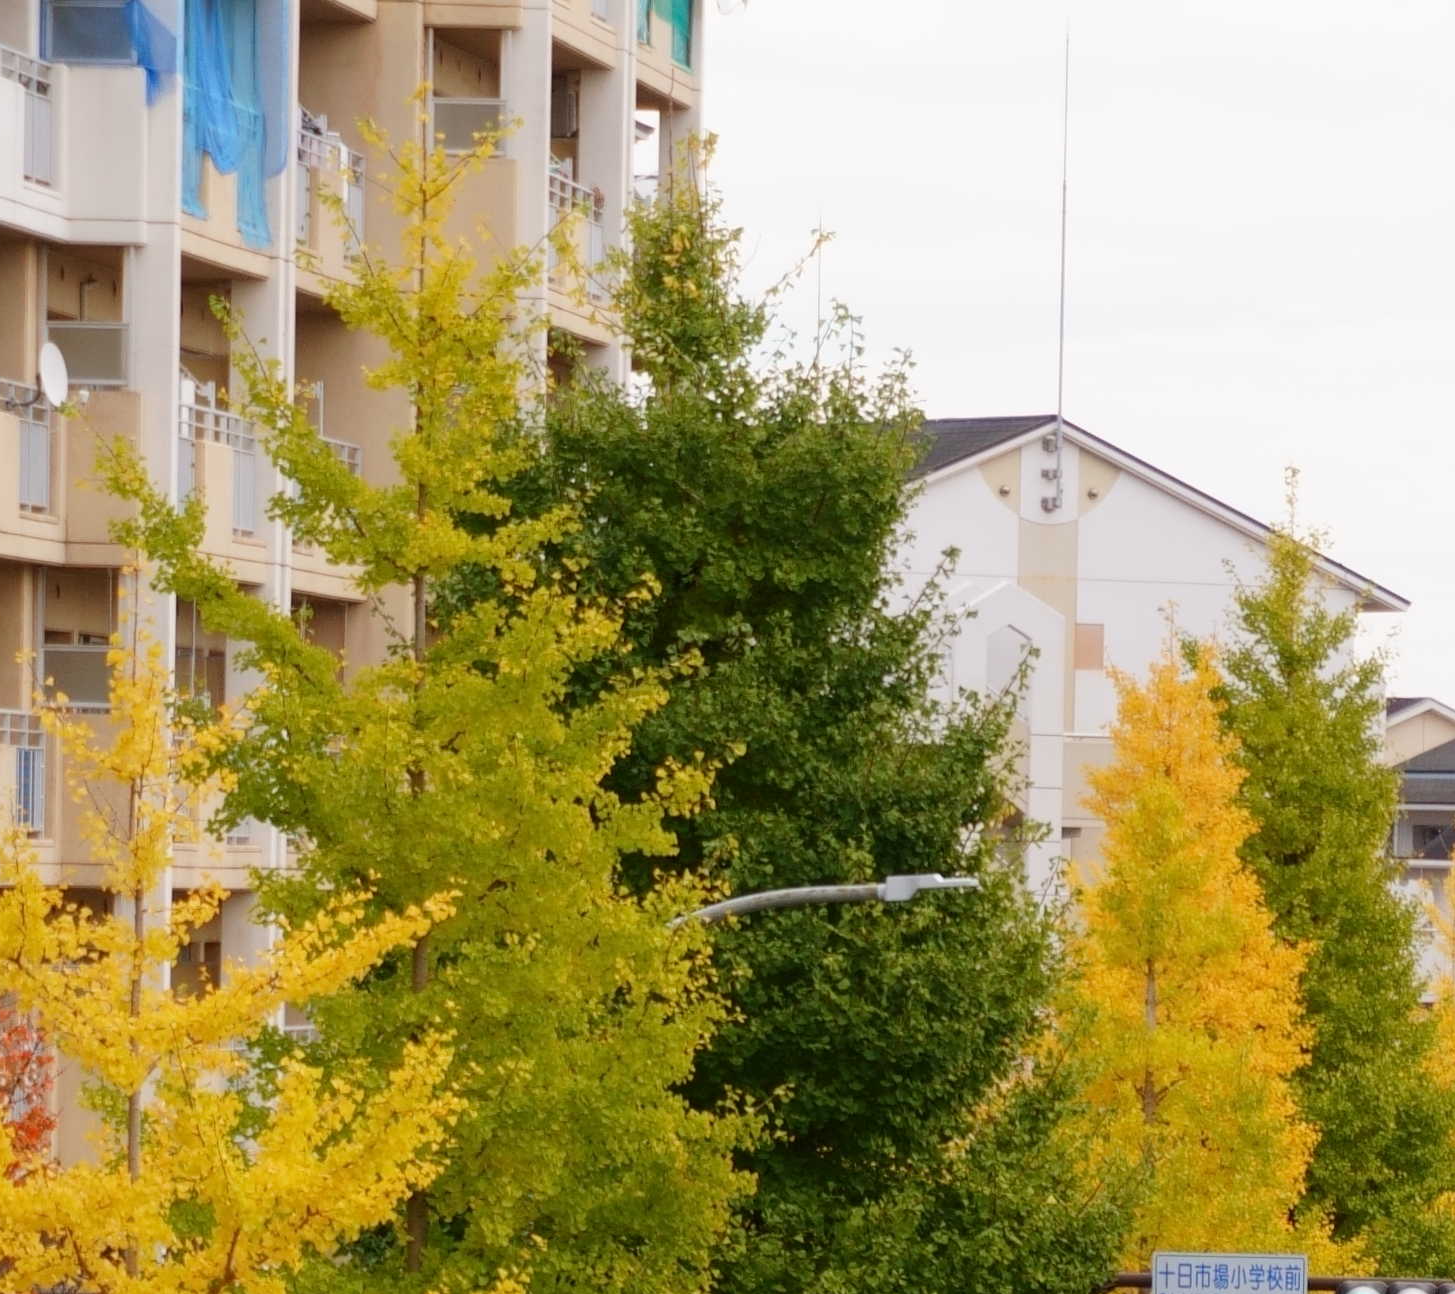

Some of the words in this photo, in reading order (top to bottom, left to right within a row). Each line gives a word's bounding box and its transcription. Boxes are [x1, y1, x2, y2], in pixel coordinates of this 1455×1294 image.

[1159, 1262, 1301, 1291] 十日市場小学校前
